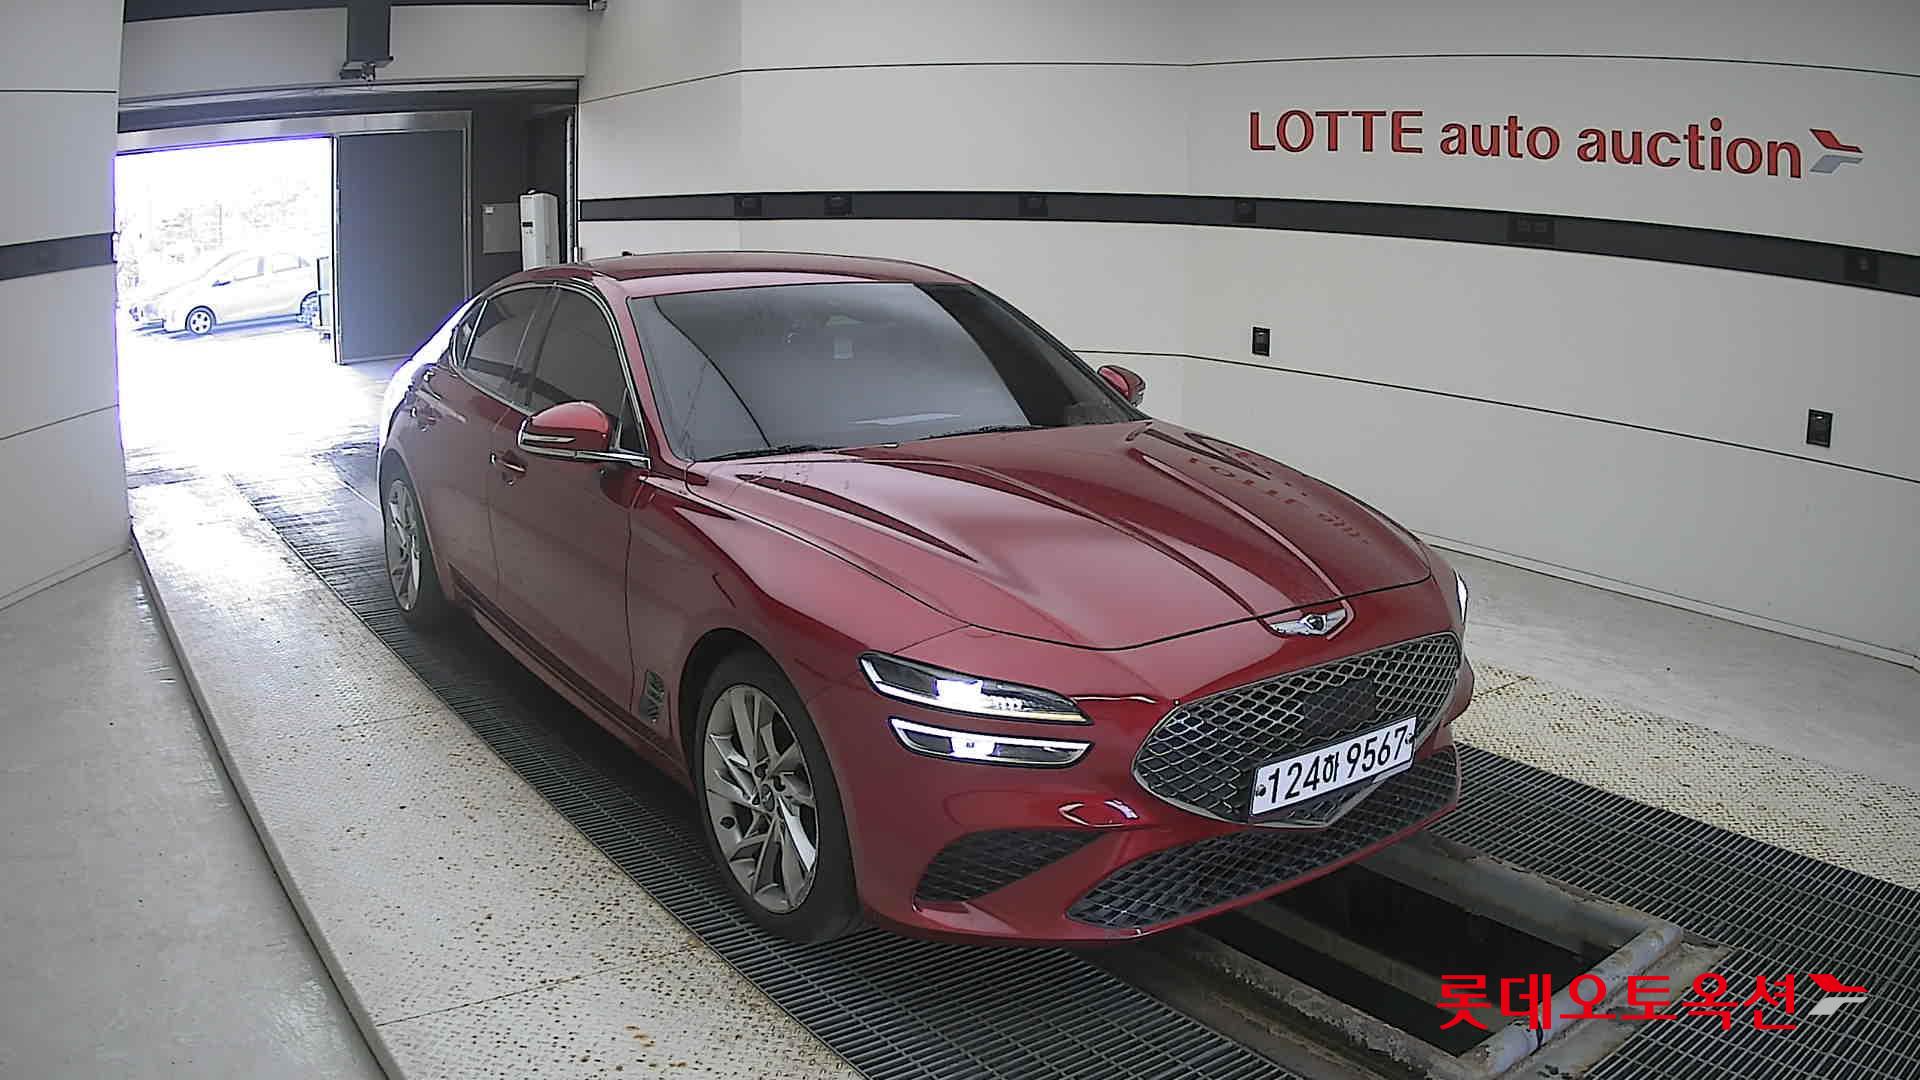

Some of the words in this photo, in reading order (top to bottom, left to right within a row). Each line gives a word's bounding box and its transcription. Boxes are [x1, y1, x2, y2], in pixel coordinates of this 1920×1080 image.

[1249, 110, 1424, 154] LOTTE
[1440, 115, 1561, 161] auto
[1576, 117, 1802, 179] auction
[1268, 751, 1340, 804] 124하
[1346, 724, 1409, 779] 9567
